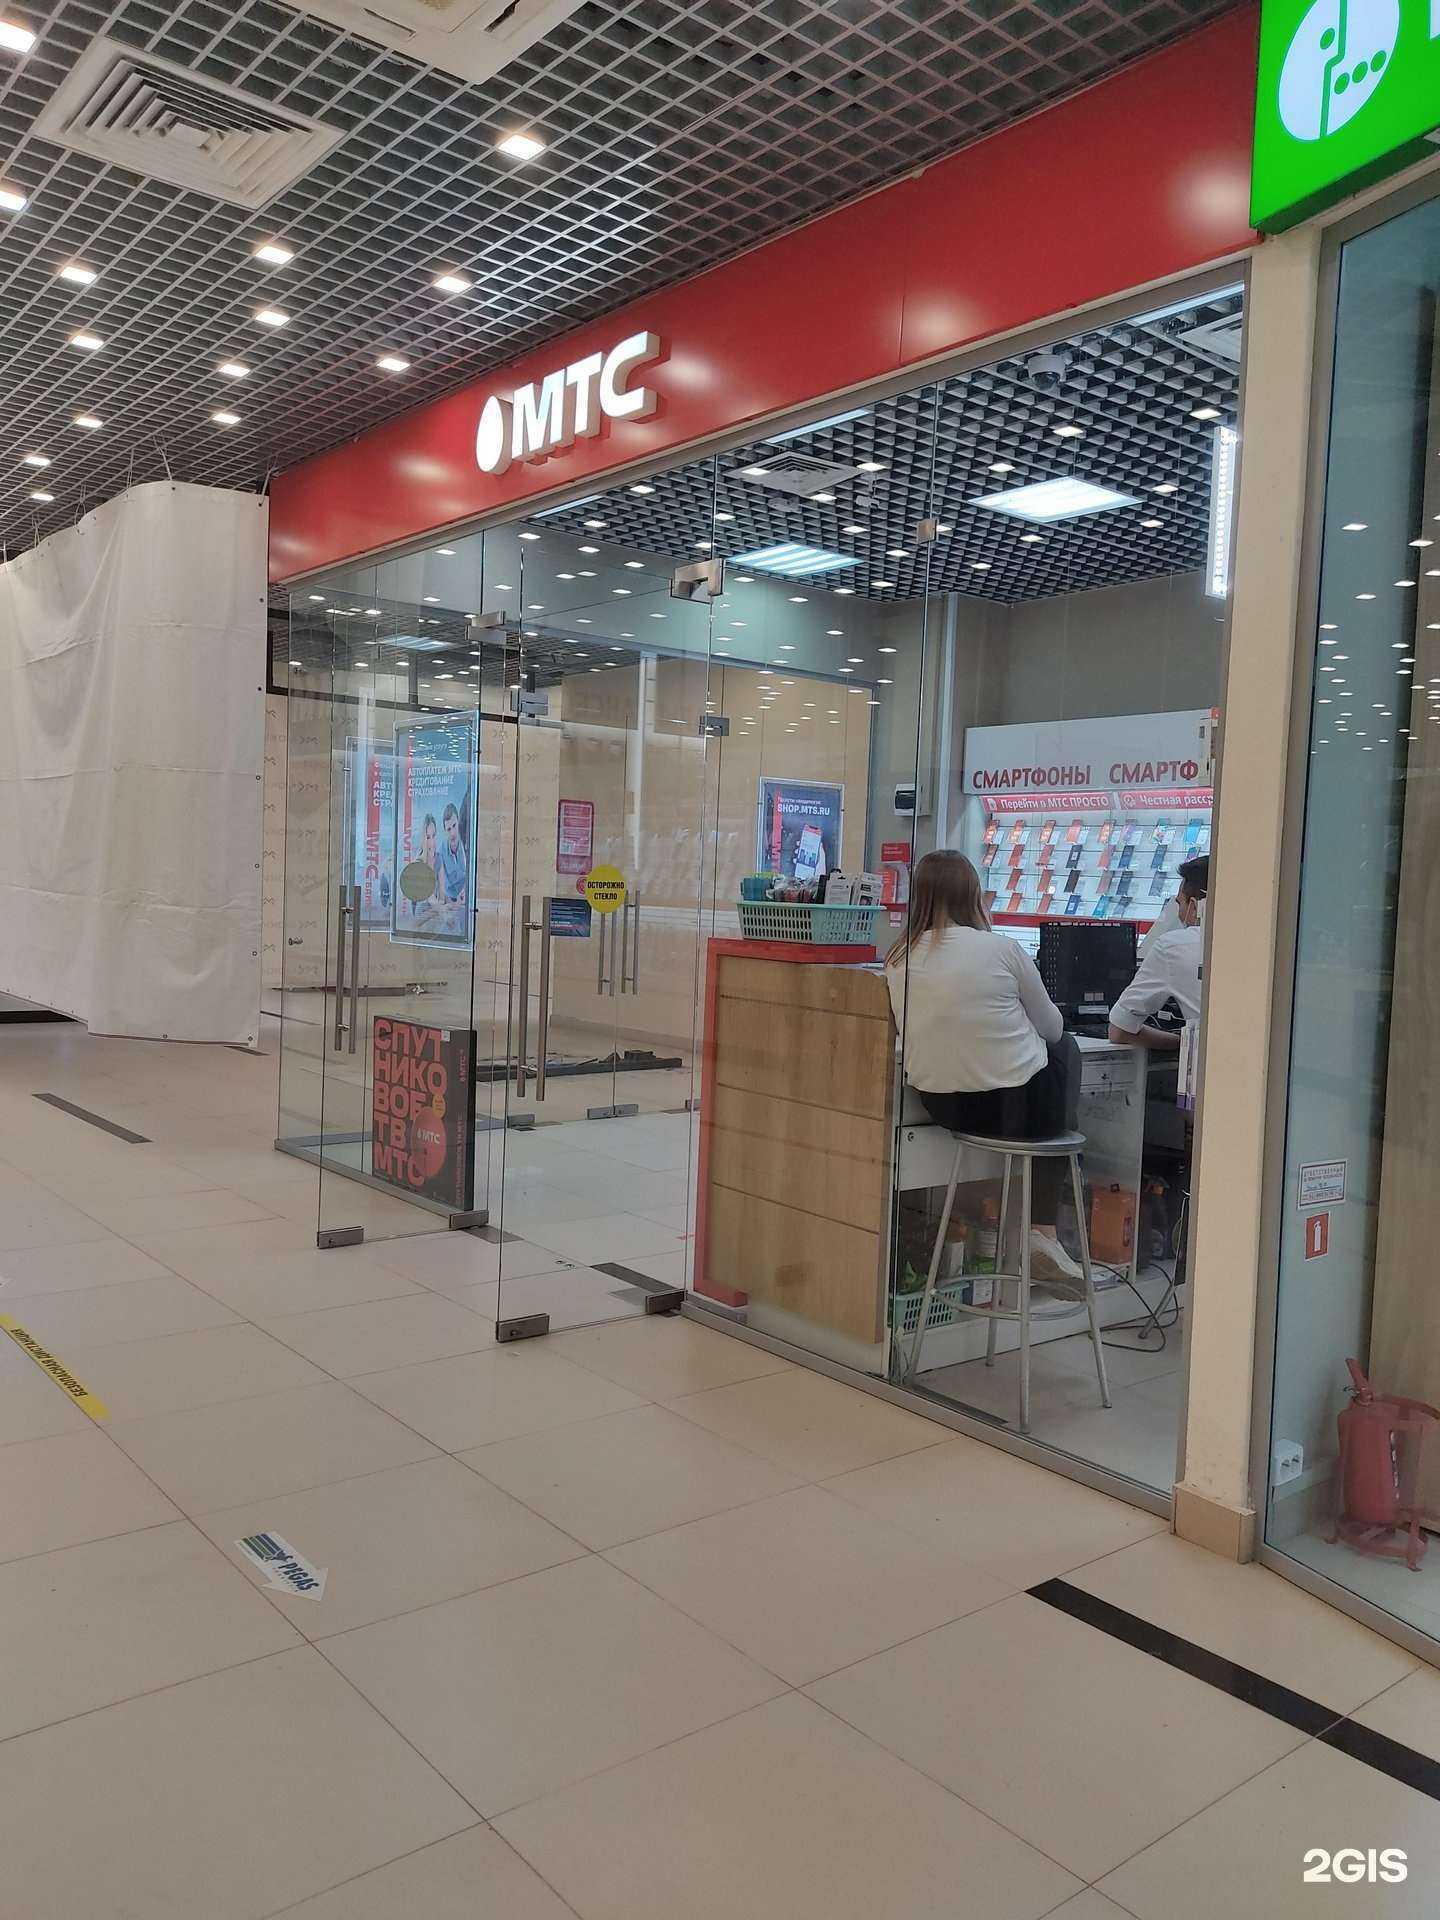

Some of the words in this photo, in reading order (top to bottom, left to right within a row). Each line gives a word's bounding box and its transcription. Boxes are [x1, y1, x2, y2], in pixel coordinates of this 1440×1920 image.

[512, 331, 655, 460] МТС
[973, 765, 1091, 789] СМАРТФОНЫ
[1109, 760, 1199, 784] СМАРТФ
[777, 803, 830, 816] SHOP.MTS.RU
[1001, 798, 1039, 810] Перейти
[1047, 797, 1068, 808] МТС
[1070, 796, 1109, 808] ПРОСТО
[1140, 796, 1181, 806] Честная
[587, 881, 625, 890] ОСТОРОЖНО
[594, 892, 618, 901] СТЕКЛО
[375, 1019, 441, 1063] СПУТ
[375, 1049, 448, 1094] НИКО
[375, 1110, 407, 1152] ТВ
[422, 1128, 440, 1145] МТС
[41, 1359, 88, 1397] БЕЗОПАСНАЯ
[278, 1562, 320, 1591] PEGAS
